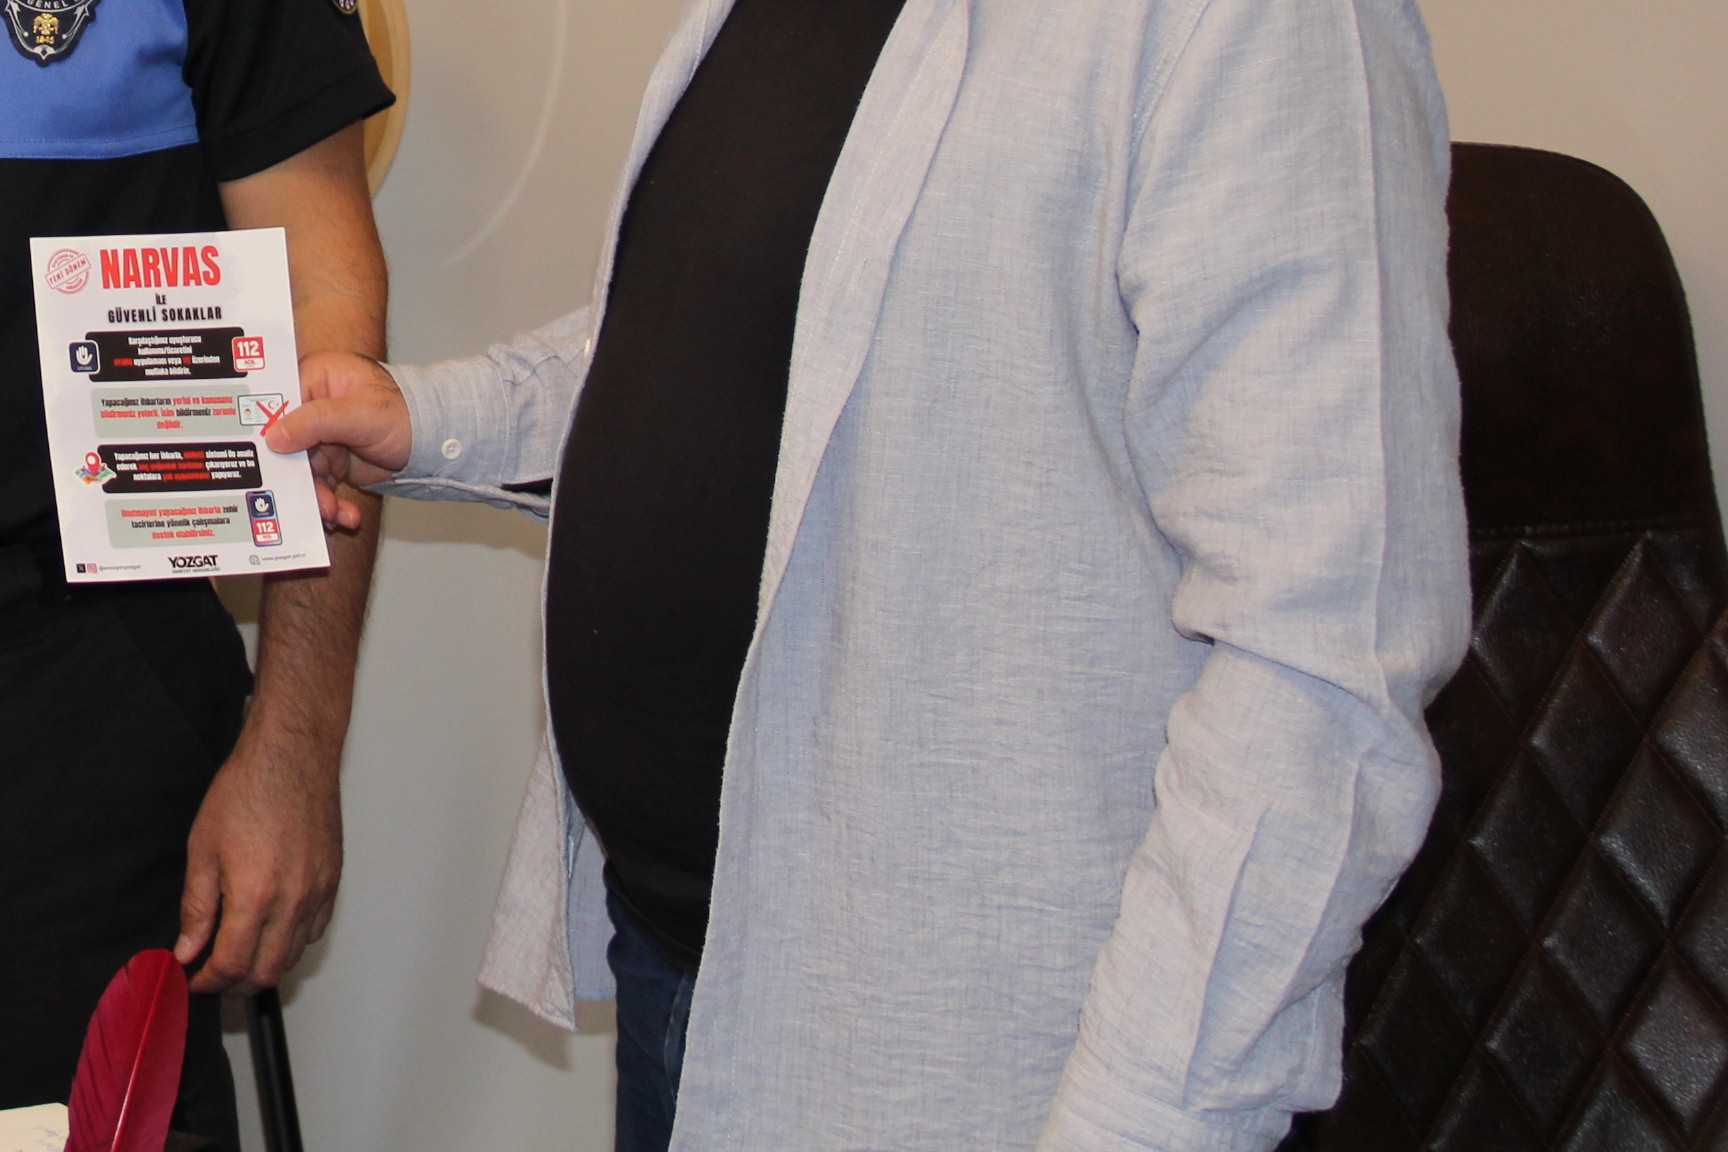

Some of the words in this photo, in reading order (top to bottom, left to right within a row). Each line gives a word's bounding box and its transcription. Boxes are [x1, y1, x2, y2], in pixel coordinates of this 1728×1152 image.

[99, 244, 221, 290] NARVAS
[155, 292, 167, 305] İLE
[108, 305, 157, 324] GÜVENLİ
[161, 306, 222, 322] SOKAKLAR
[237, 340, 261, 356] 112
[256, 521, 275, 534] 112
[168, 554, 219, 569] YOZGAT
